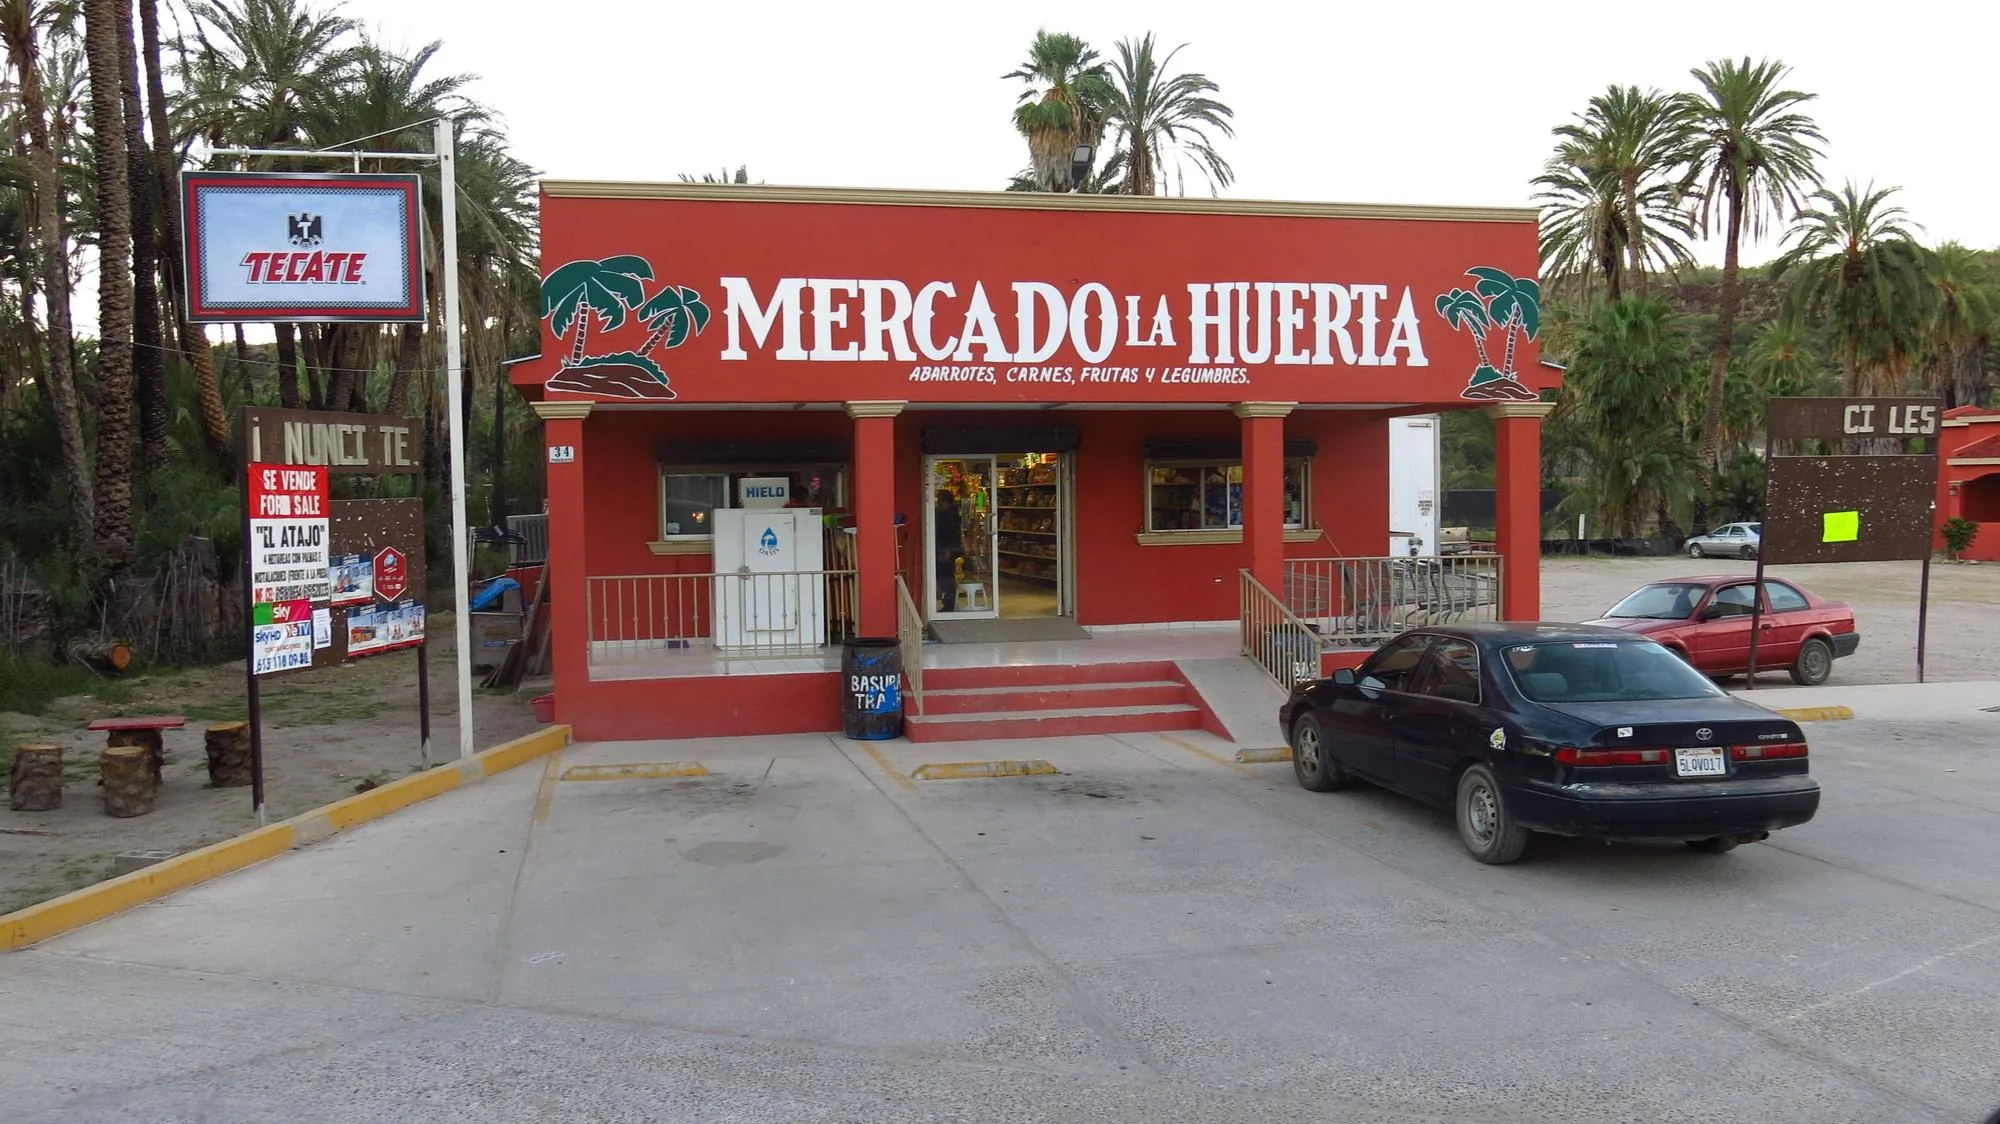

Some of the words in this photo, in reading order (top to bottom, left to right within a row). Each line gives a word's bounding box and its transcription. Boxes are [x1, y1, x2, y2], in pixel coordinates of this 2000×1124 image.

[240, 250, 367, 284] TECATE
[719, 276, 1119, 364] MERCADO
[1124, 293, 1177, 347] LA
[1186, 281, 1429, 368] HUERTA
[908, 366, 997, 386] ABARROTES,
[1006, 366, 1076, 386] CARNES,
[1080, 367, 1139, 384] FRUTAS
[1160, 367, 1251, 385] LEGUMBRES.
[1843, 404, 1876, 434] CI
[1888, 405, 1937, 434] LES
[263, 469, 277, 491] SE
[281, 470, 316, 491] VENDE
[746, 486, 785, 498] HIELO
[294, 494, 321, 516] SALE
[280, 524, 326, 548] ATAJO"
